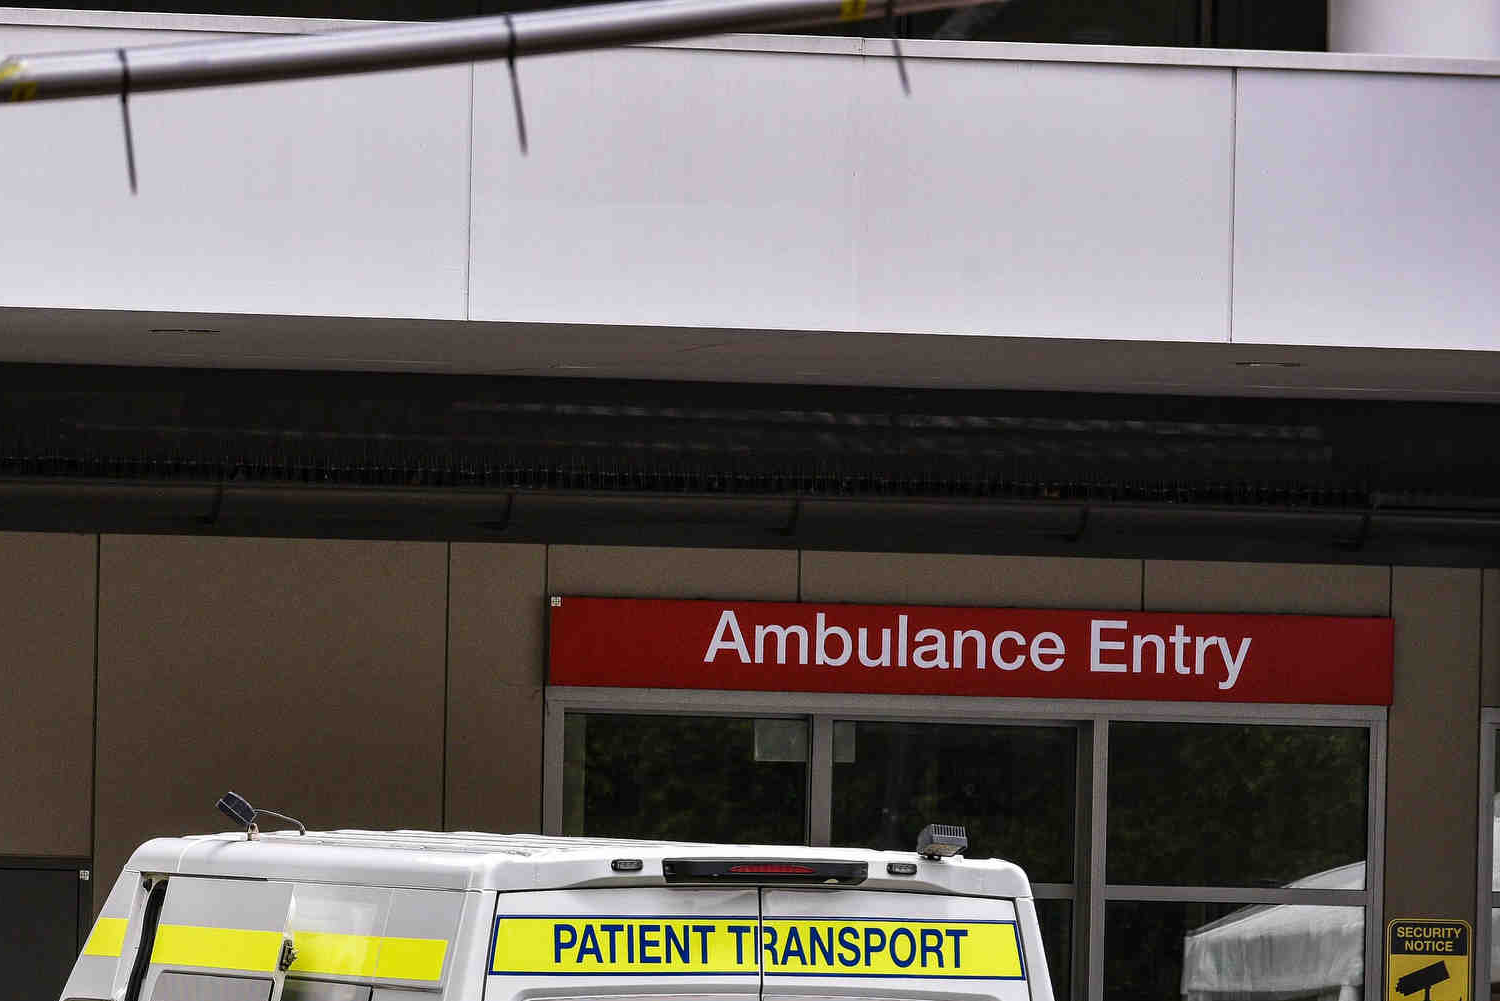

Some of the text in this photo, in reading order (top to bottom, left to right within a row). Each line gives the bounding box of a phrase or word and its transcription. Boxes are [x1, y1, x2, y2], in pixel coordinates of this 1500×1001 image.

[703, 609, 1253, 690] Ambulance Entry
[553, 923, 969, 969] PATIENT TRANSPORT
[1396, 926, 1462, 938] SECURITY
[1404, 940, 1453, 952] NOTICE
